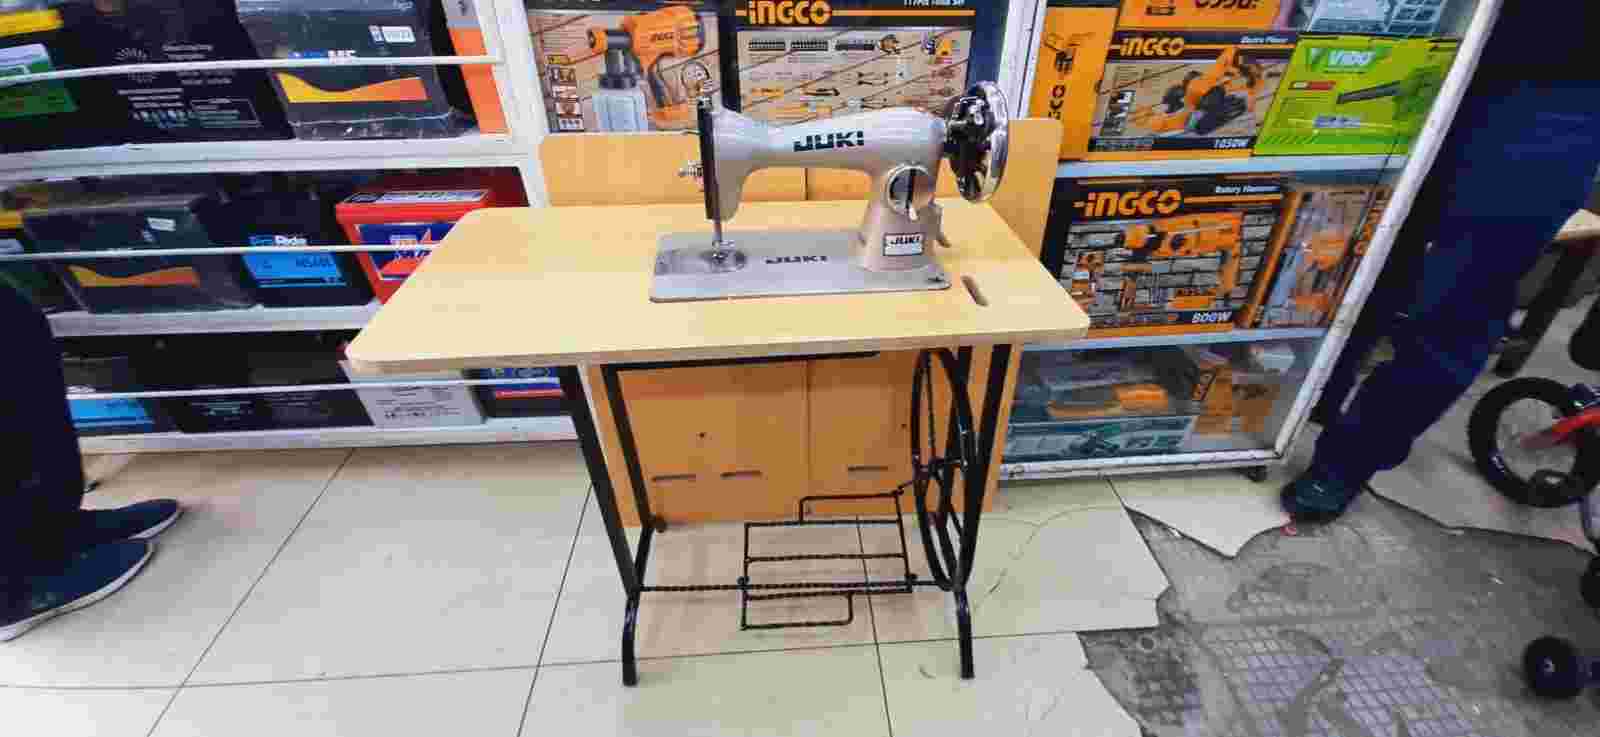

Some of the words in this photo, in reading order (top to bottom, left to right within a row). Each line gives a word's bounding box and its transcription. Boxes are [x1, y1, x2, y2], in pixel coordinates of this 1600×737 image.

[1120, 37, 1185, 56] INGCO
[793, 130, 865, 152] JUKI
[1085, 190, 1182, 217] INGCO
[764, 255, 829, 265] JUKI
